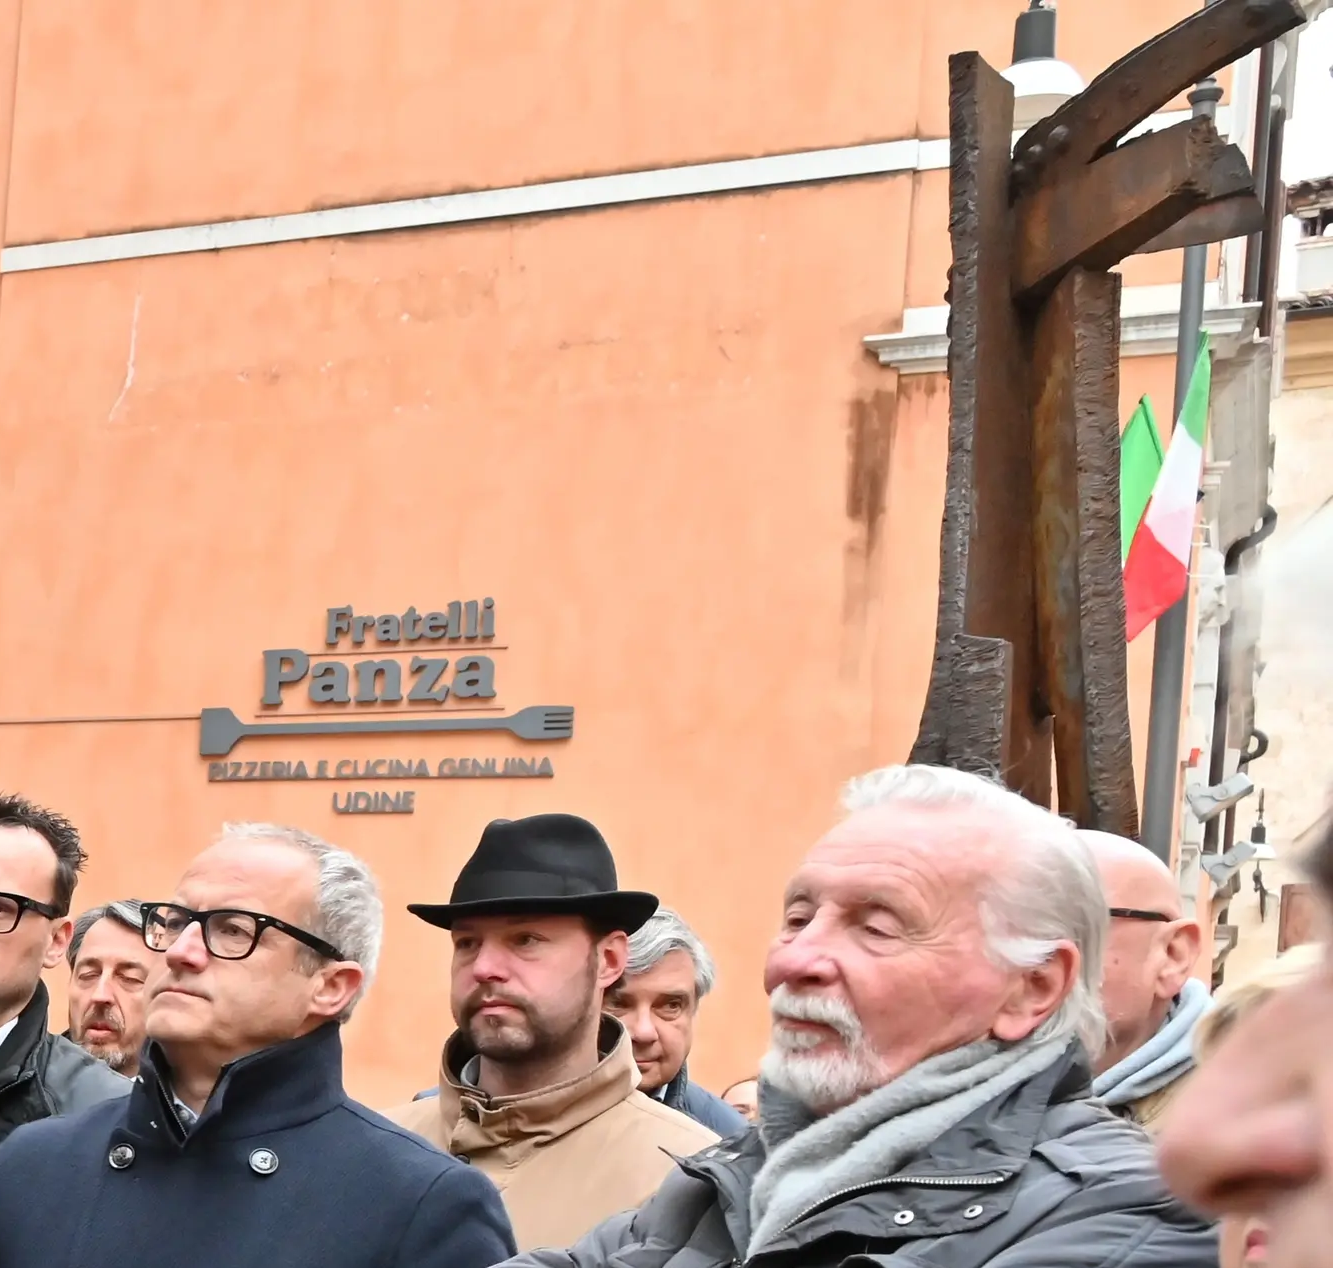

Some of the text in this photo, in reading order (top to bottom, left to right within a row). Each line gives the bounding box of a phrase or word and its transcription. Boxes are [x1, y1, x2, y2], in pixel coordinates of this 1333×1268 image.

[325, 596, 496, 646] Fratelli
[260, 648, 497, 706] Panza
[208, 756, 554, 783] PIZZERIA E CUCINA GENUINA
[333, 790, 416, 815] UDINE
